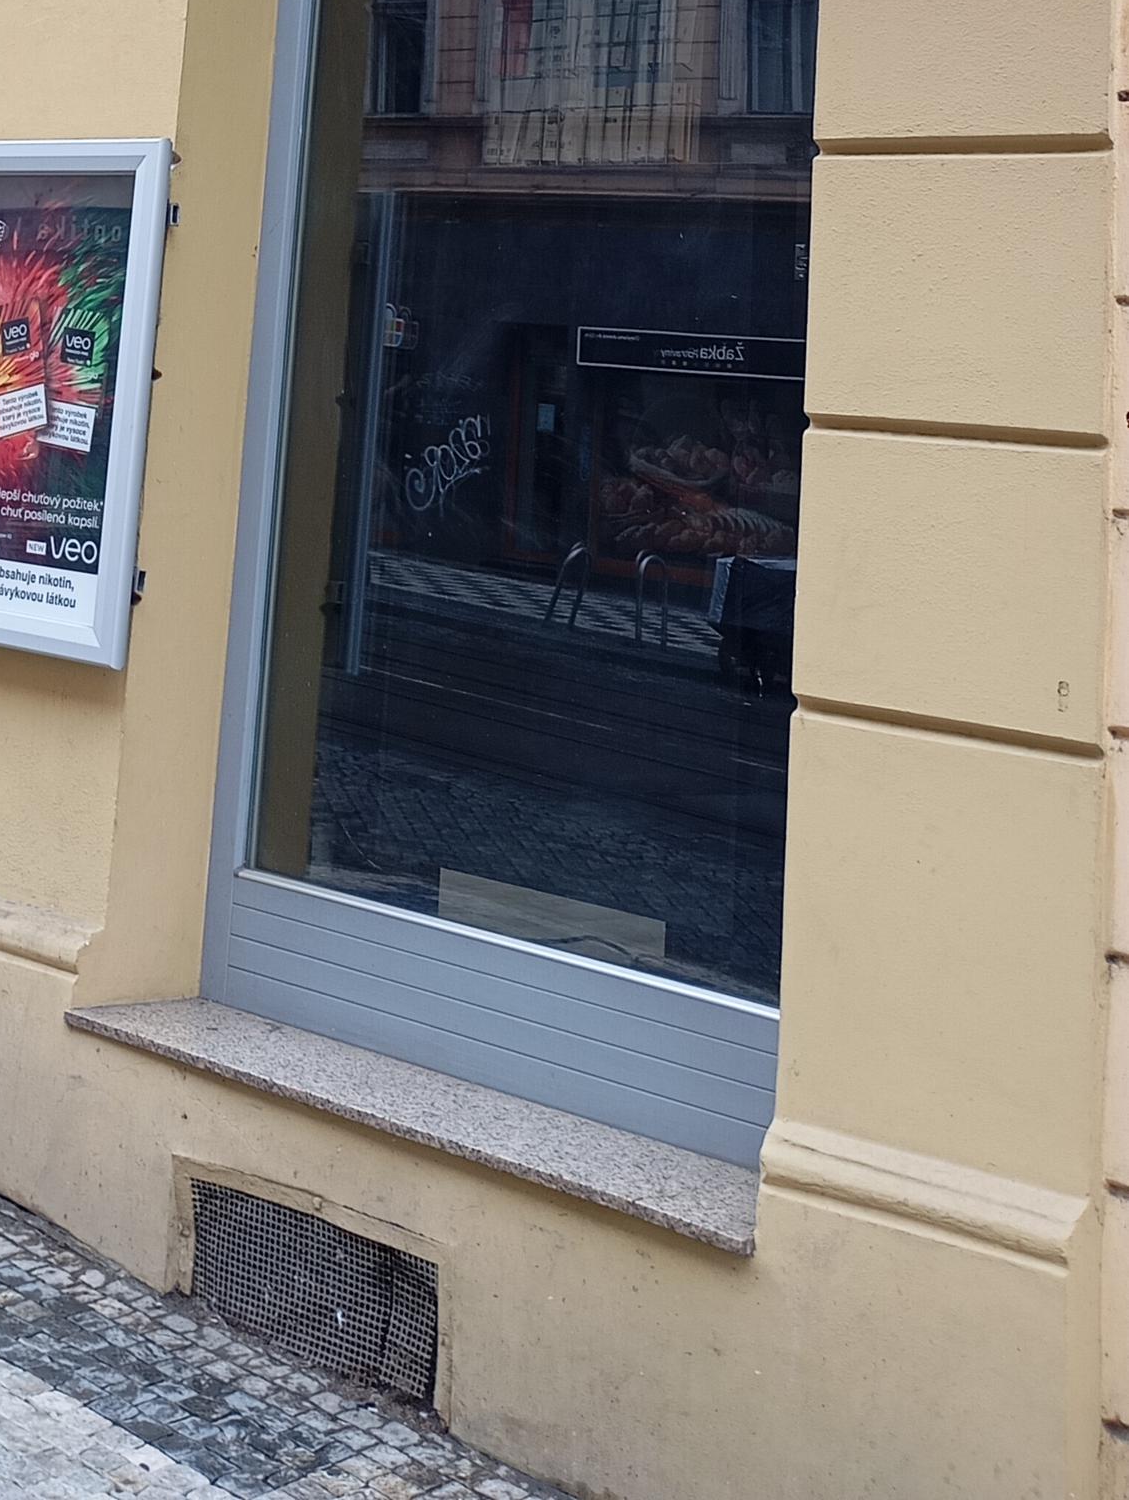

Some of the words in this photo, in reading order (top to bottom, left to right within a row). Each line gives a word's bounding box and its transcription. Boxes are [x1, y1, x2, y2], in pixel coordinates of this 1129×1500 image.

[3, 323, 28, 341] veo
[65, 334, 92, 351] veo
[21, 491, 62, 509] chuťový
[0, 504, 24, 519] chuť
[24, 508, 66, 524] posílená
[27, 542, 46, 554] NEW
[49, 535, 98, 565] veo
[38, 572, 75, 593] nikotin,
[45, 591, 77, 609] látkou
